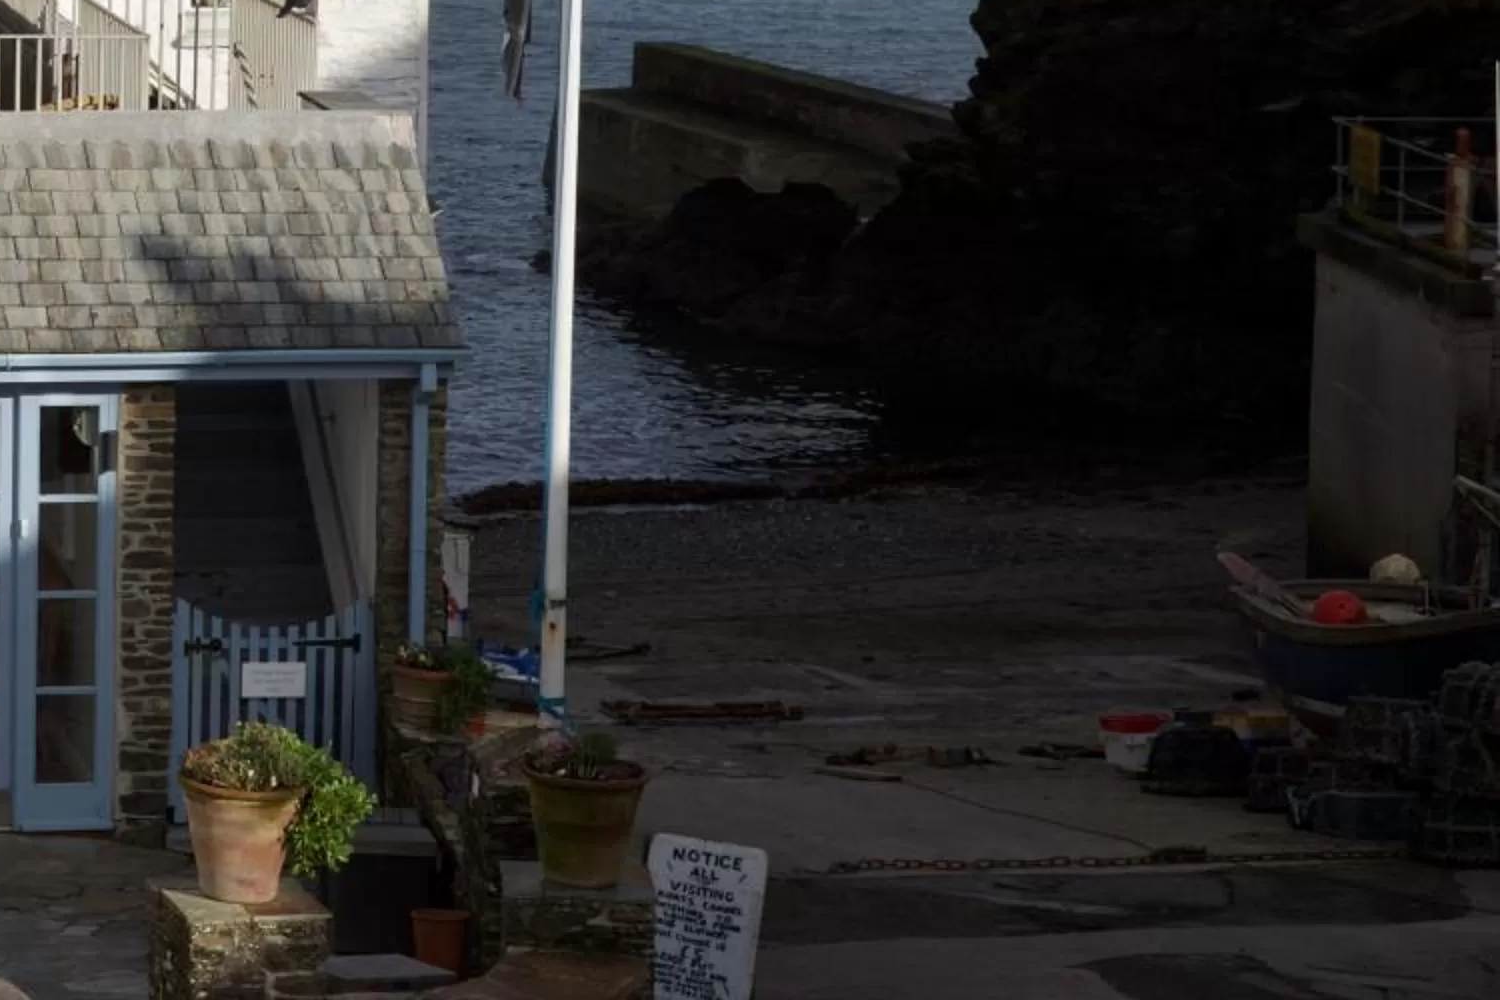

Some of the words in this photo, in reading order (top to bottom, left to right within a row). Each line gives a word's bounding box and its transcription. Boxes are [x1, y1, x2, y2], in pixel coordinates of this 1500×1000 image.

[672, 847, 744, 872] NOTICE
[690, 867, 720, 881] ALL
[669, 879, 735, 903] VISITING
